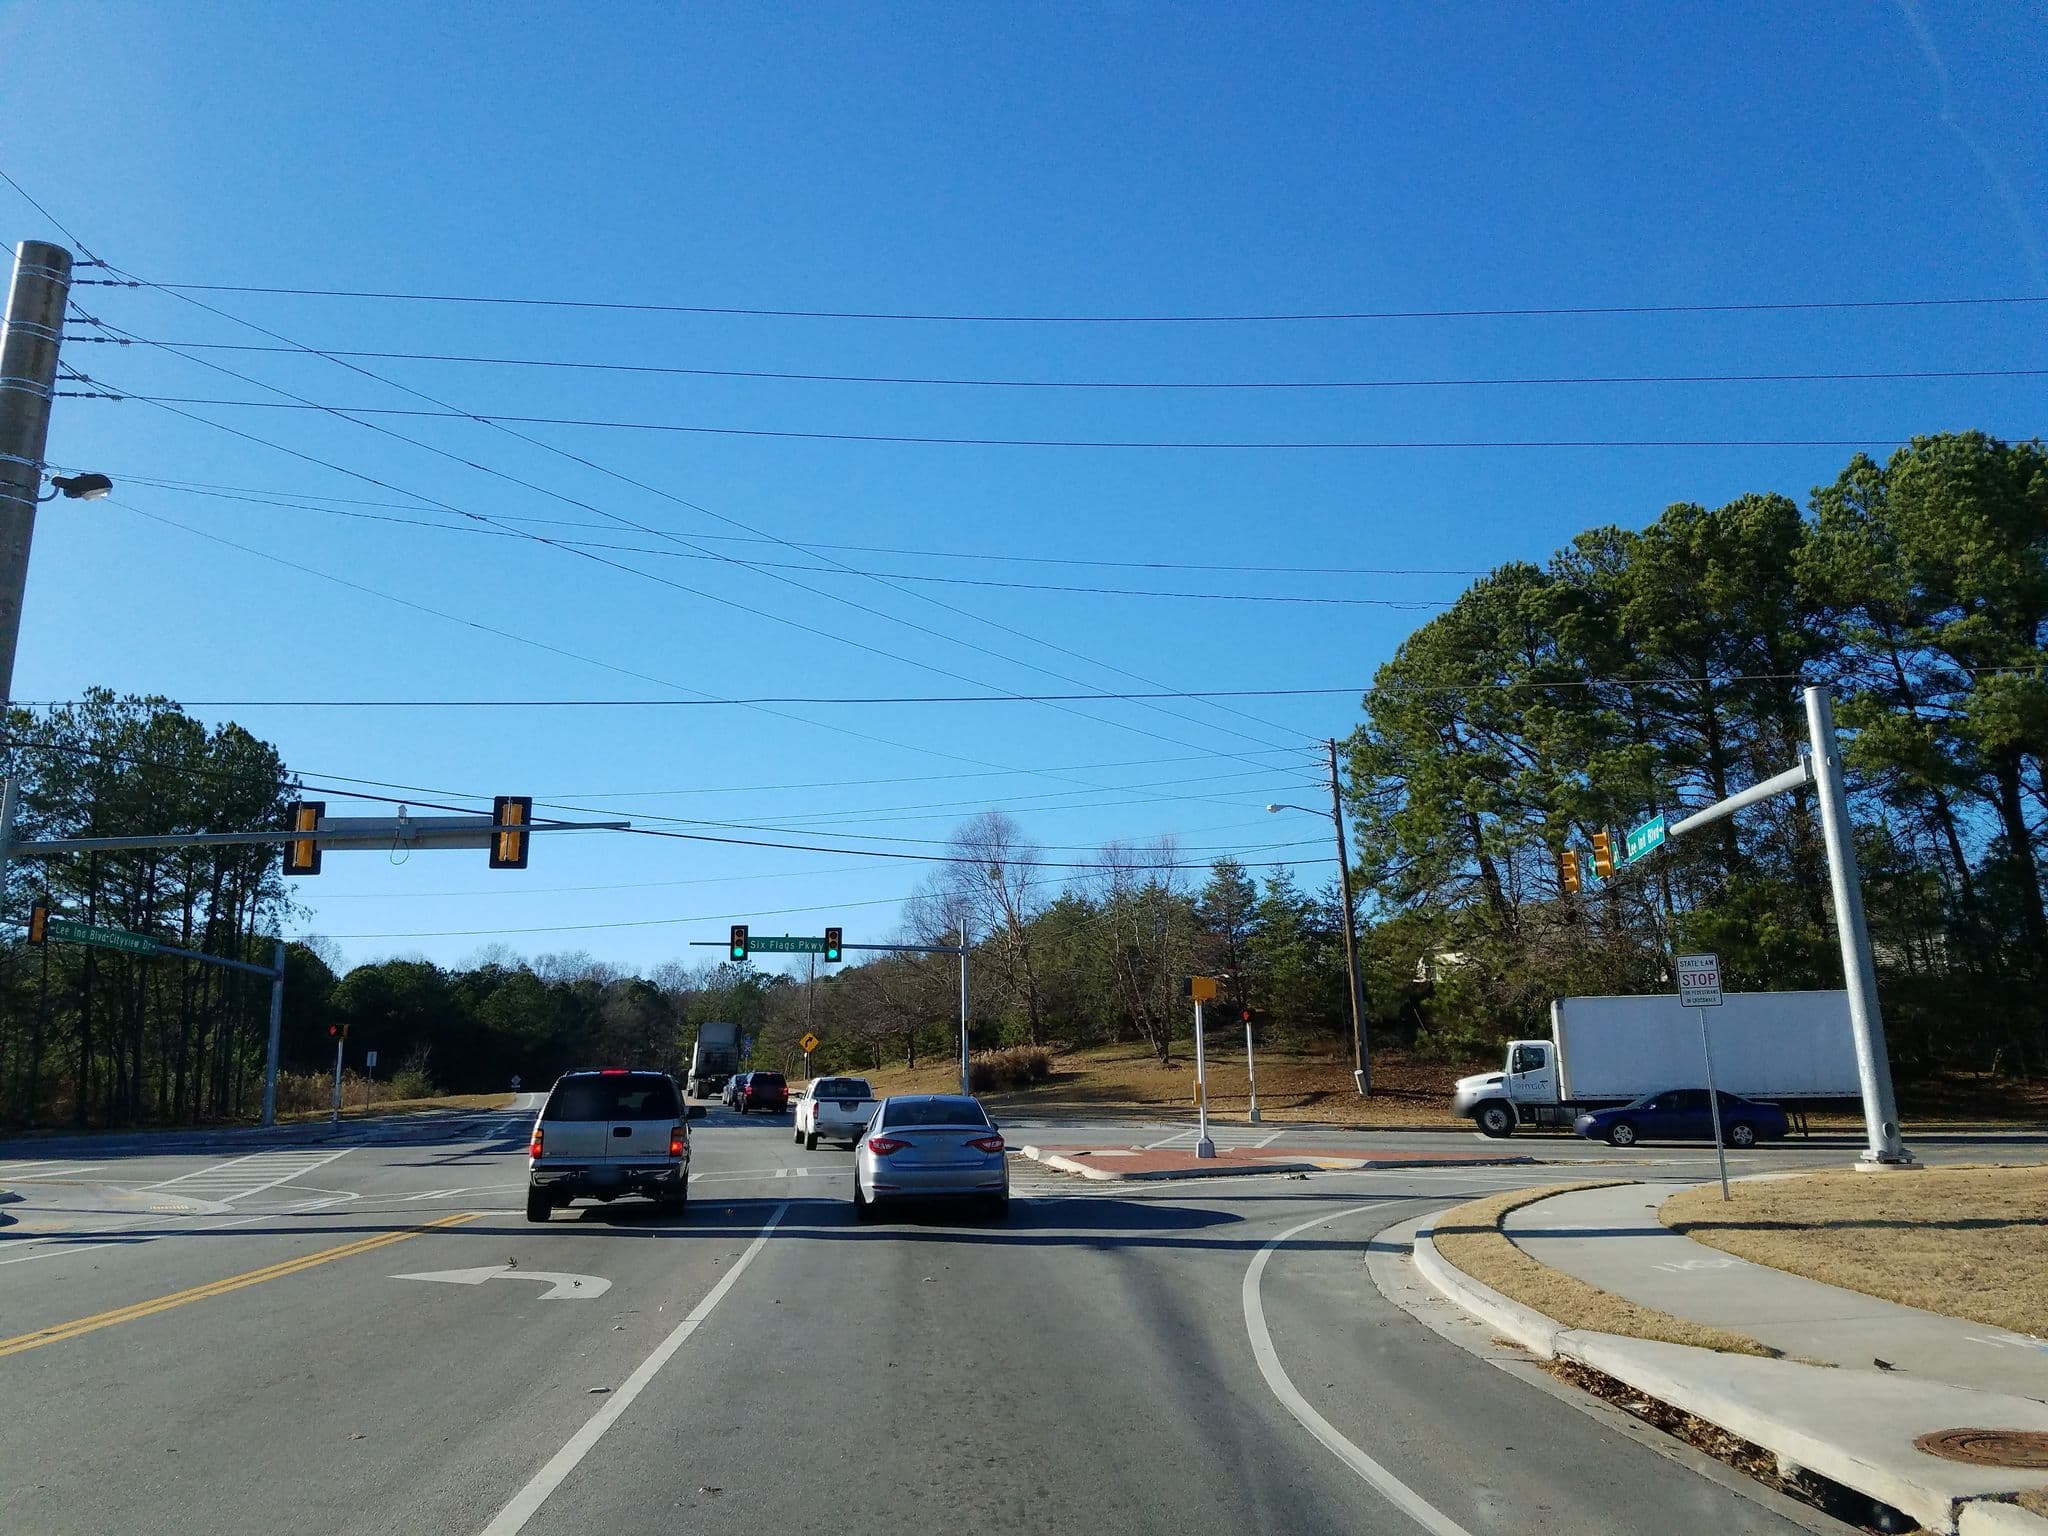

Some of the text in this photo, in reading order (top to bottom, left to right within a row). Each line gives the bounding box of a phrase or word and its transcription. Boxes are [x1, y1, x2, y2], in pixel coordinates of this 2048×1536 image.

[1628, 842, 1637, 857] Lee
[55, 923, 69, 936] Lee
[750, 941, 824, 951] Six Flags Pkwy
[1700, 959, 1714, 967] LAW
[1682, 973, 1716, 986] STOP
